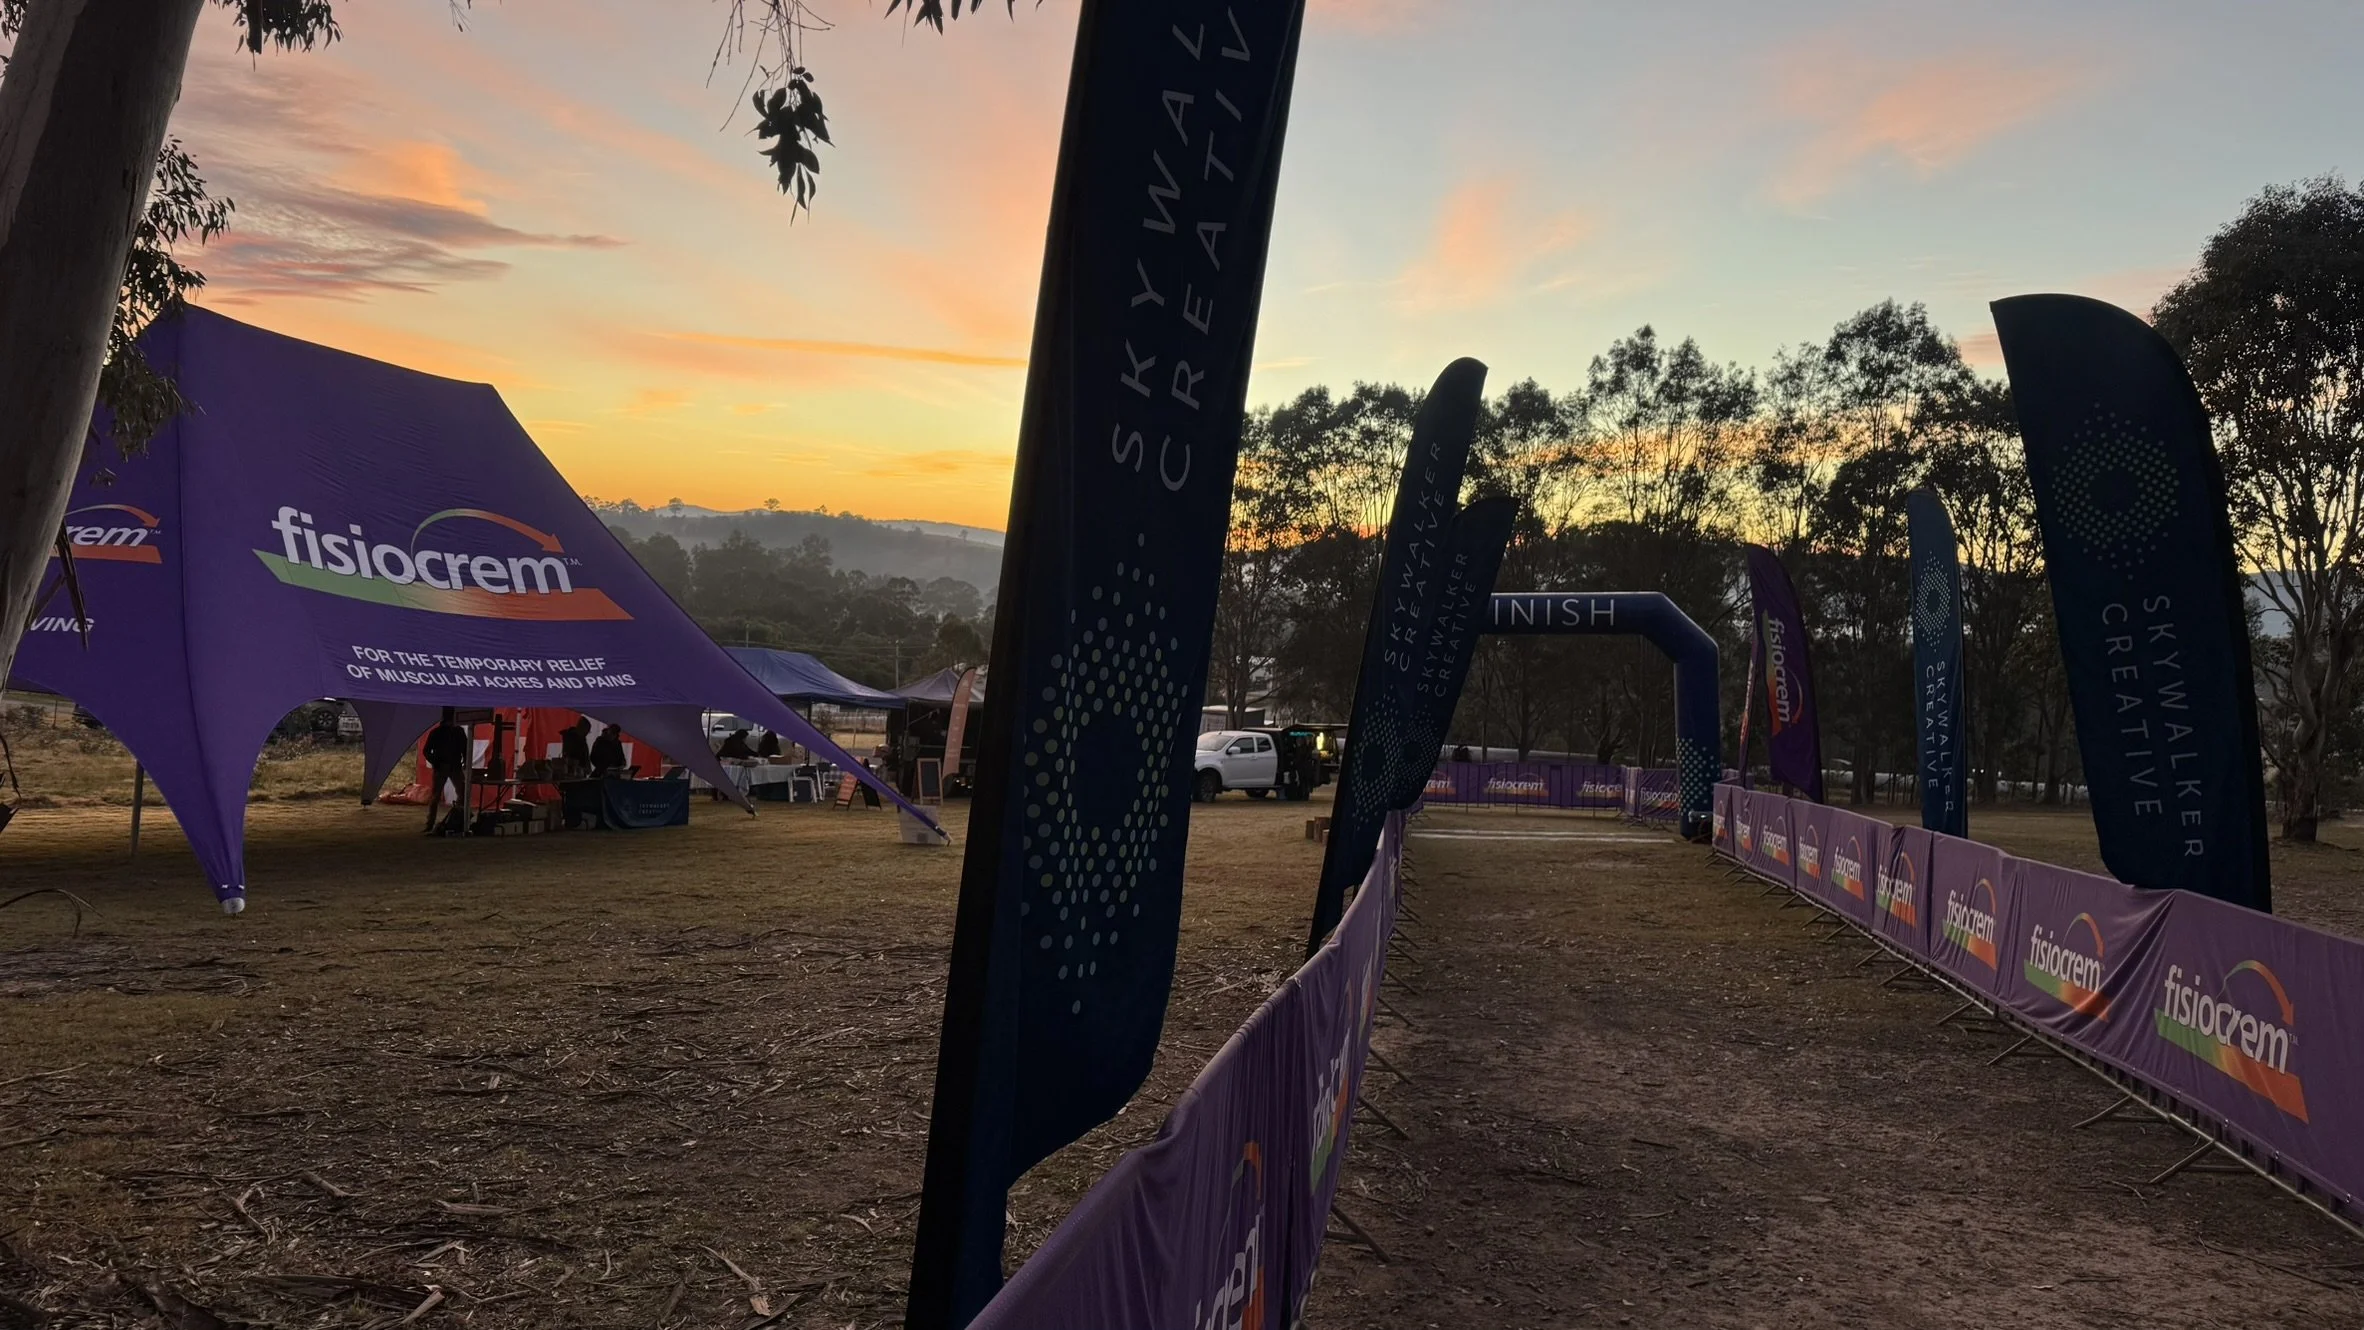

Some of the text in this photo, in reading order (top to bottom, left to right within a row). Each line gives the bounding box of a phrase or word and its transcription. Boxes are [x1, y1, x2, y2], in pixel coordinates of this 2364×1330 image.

[1111, 23, 1204, 472] SKYWAL
[1159, 5, 1251, 492] CREATIV
[65, 525, 148, 547] rem
[271, 505, 572, 594] fisiocrem
[1385, 442, 1440, 665] SKYWALKER
[1400, 491, 1445, 672] CREATIVE
[30, 616, 94, 632] VING
[352, 645, 606, 672] FOR THE TEMPORARY RELIEF
[1417, 553, 1468, 693] SKYWALKER
[1435, 583, 1476, 697] CREATIVE
[1493, 598, 1615, 627] INISH
[346, 663, 636, 690] OF MUSCULAR ACHES AND PAINS
[1768, 617, 1790, 723] fisiocrem
[2102, 602, 2163, 816] CREATIVE
[1925, 665, 1939, 789] CREATIVE
[1936, 661, 1954, 812] SKYWALKER
[2143, 595, 2204, 857] SKYWALKER
[1488, 777, 1544, 791] fisiocrem
[1834, 845, 1861, 881] fisiocrem
[1947, 889, 1994, 944] fisiocrem
[2030, 924, 2100, 993] fisiocrem
[2164, 964, 2289, 1074] fisiocrem
